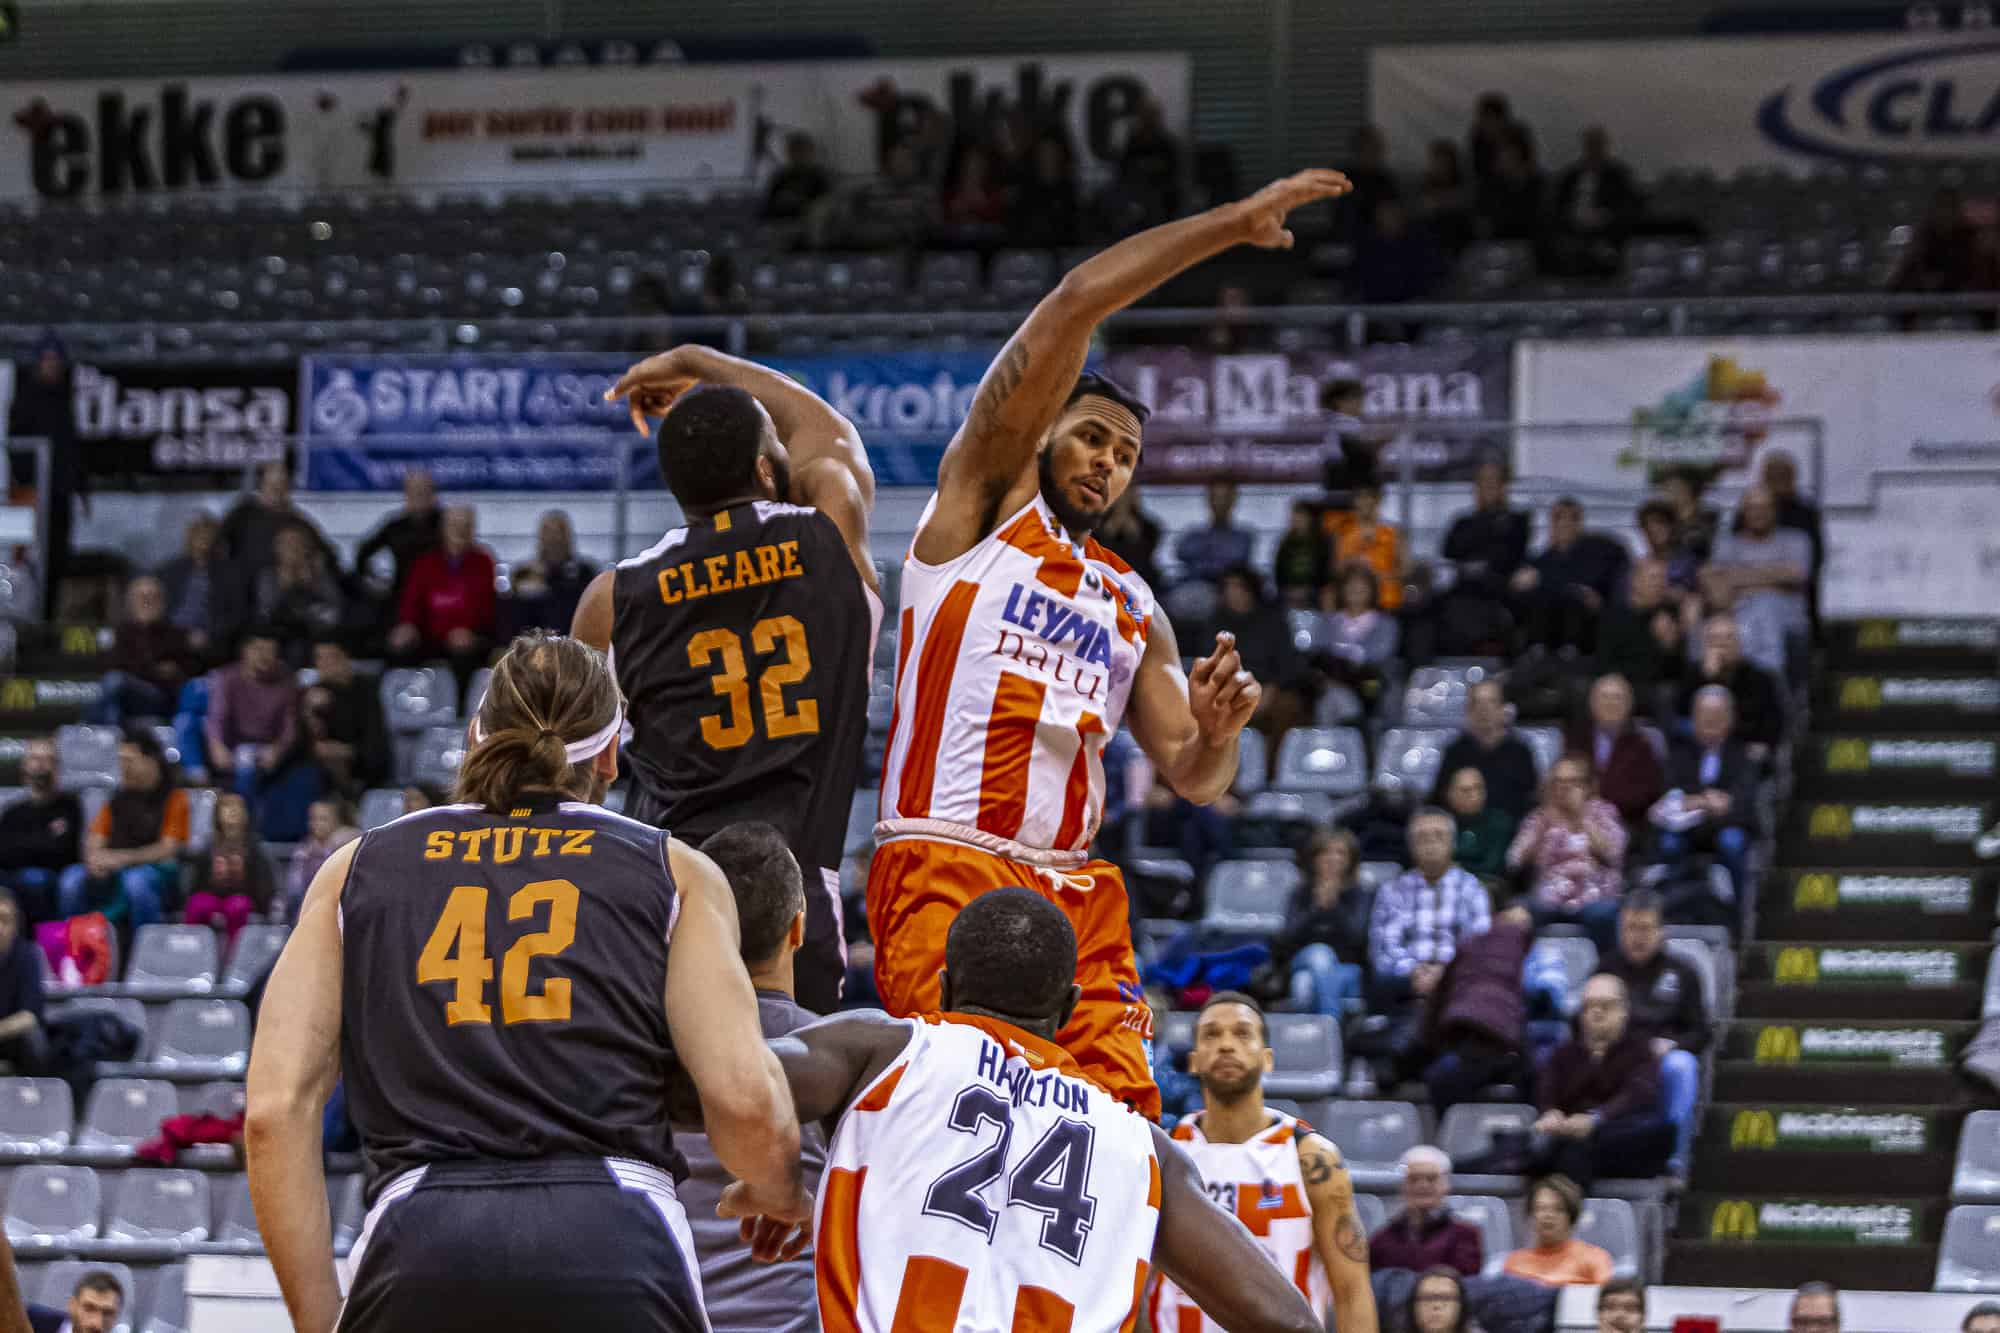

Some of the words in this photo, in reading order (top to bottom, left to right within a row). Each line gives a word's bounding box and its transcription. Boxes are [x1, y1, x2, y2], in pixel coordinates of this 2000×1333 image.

[32, 86, 287, 198] ekke
[370, 367, 526, 418] START
[658, 540, 804, 604] CLEARE
[1002, 583, 1112, 671] LEYMA
[687, 615, 820, 749] 32
[424, 827, 596, 863] STUTZ
[417, 879, 580, 1027] 42
[977, 1038, 1089, 1115] HAMILTON
[921, 1083, 1098, 1267] 24
